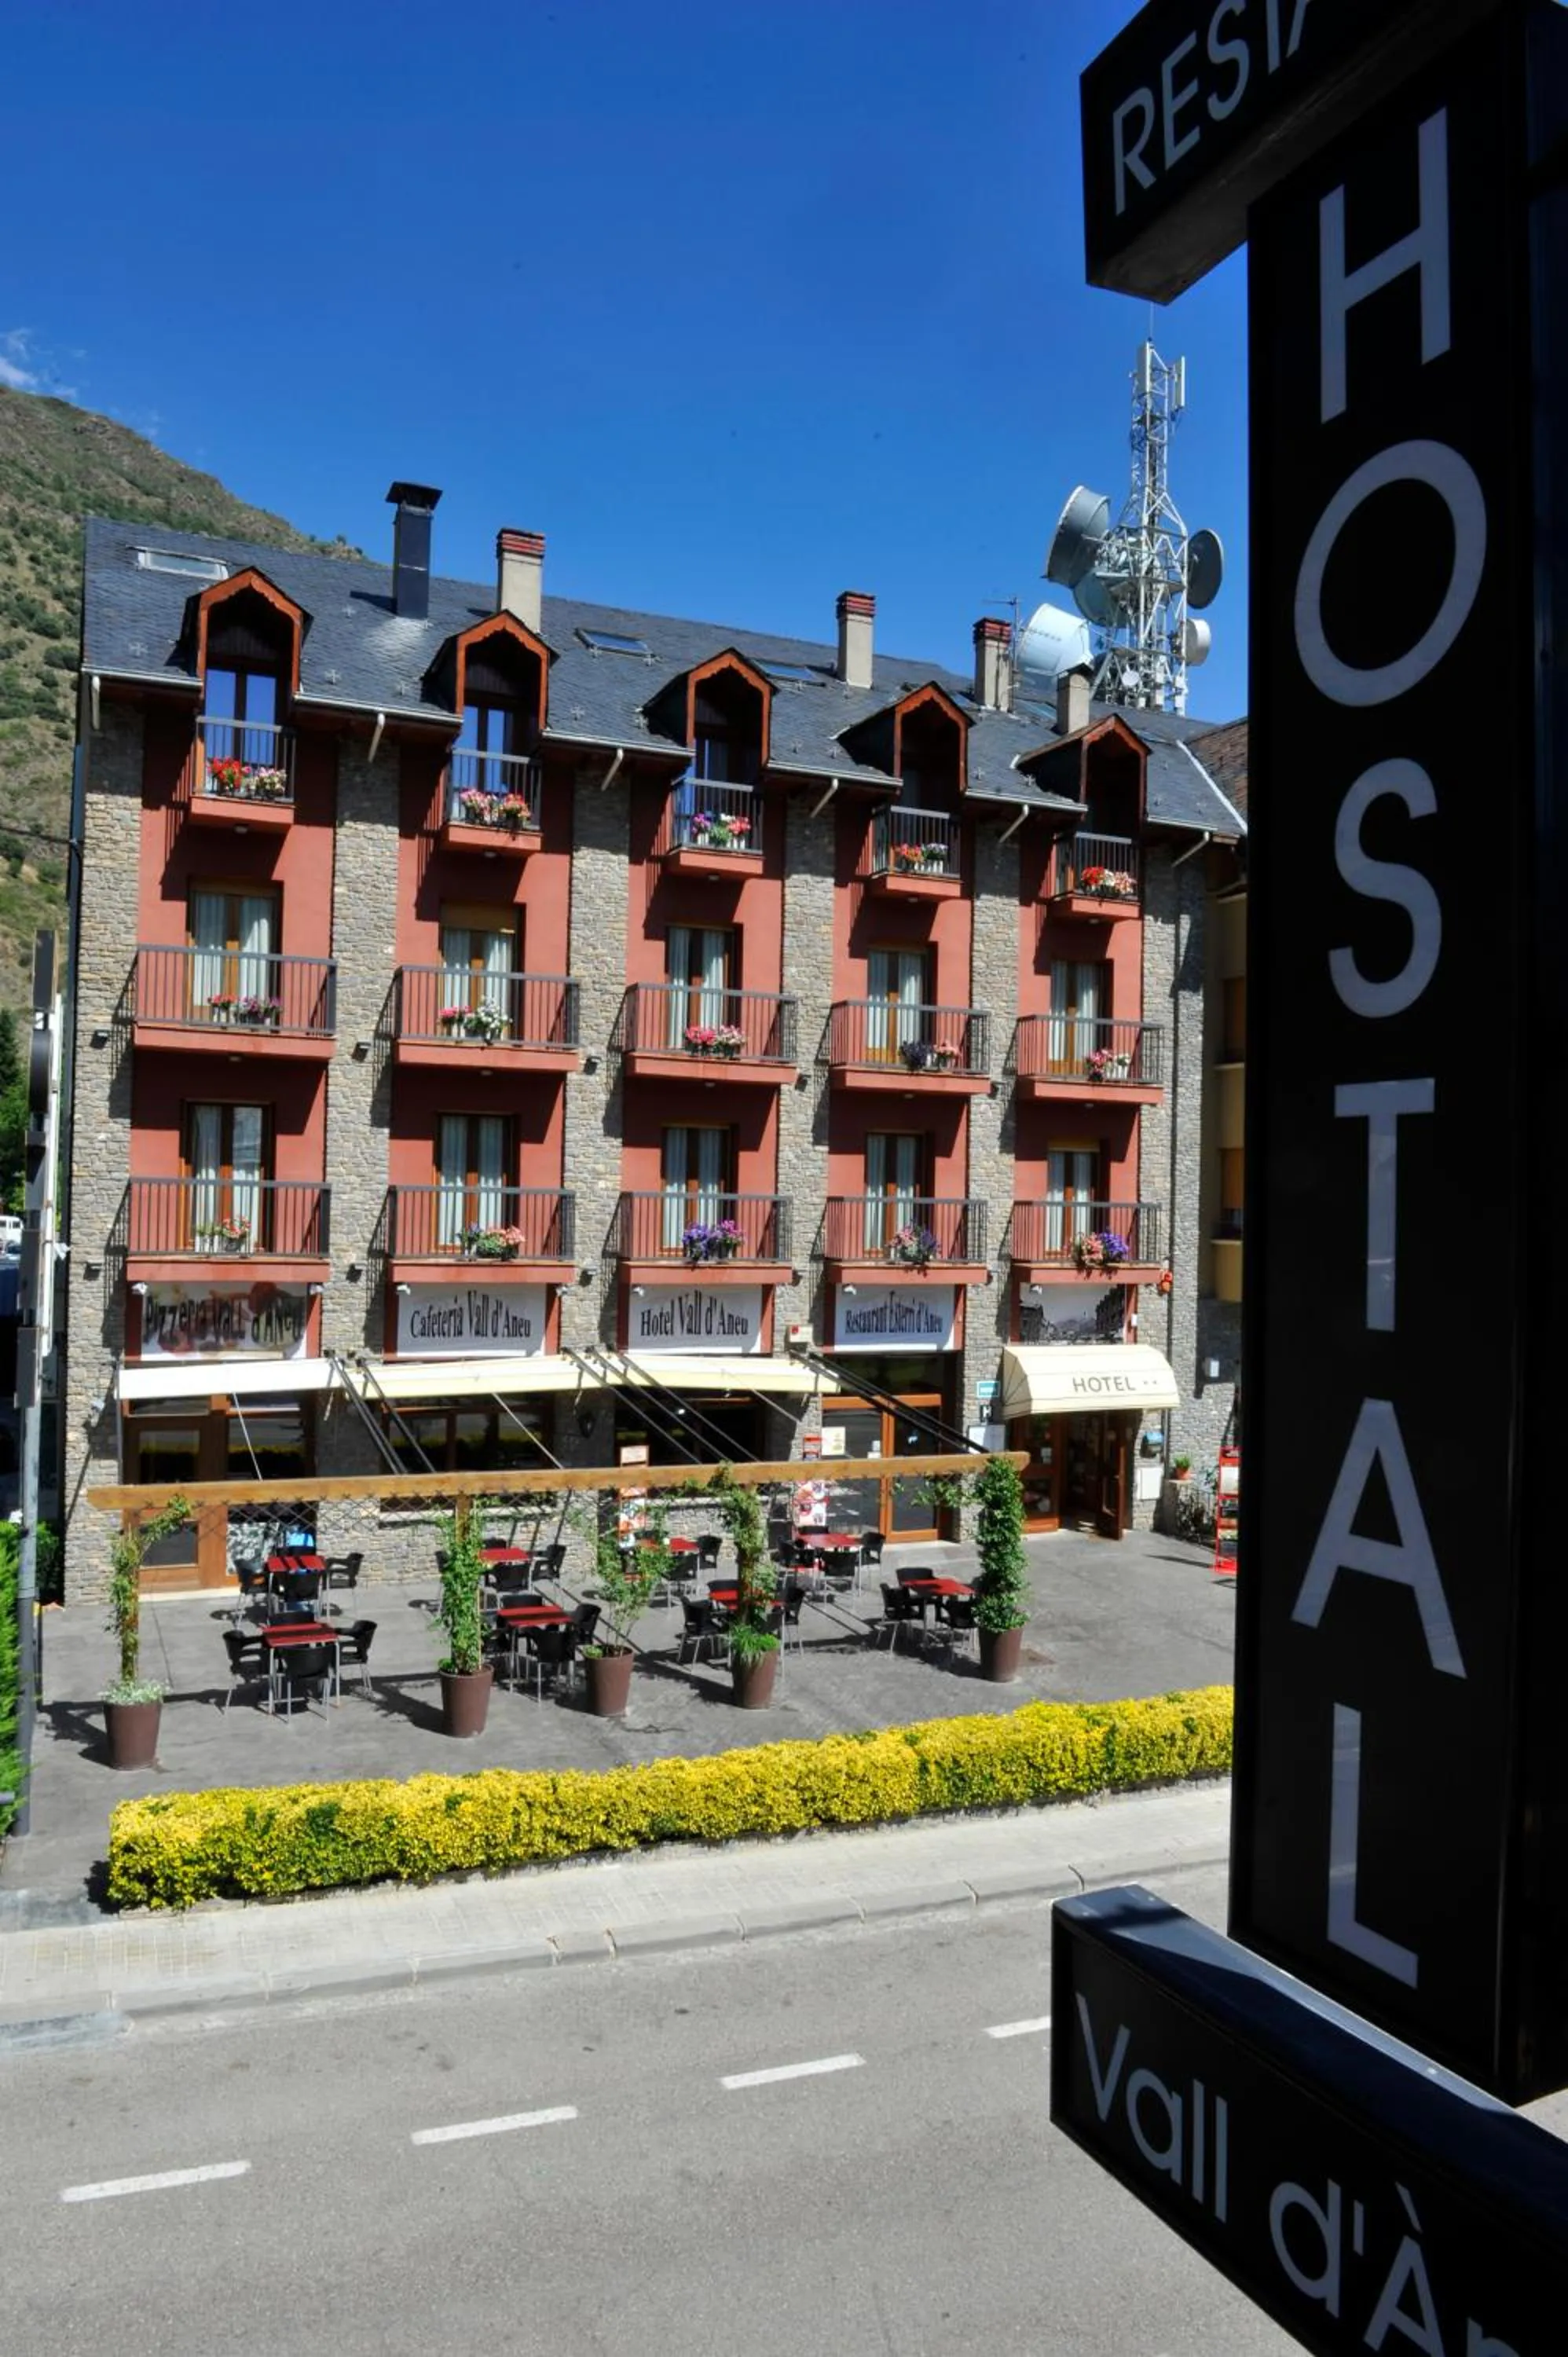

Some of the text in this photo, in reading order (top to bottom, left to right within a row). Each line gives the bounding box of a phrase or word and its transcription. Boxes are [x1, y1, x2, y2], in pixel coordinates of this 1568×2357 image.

[1293, 107, 1486, 1989] HOSTAL
[467, 1290, 489, 1337] Vall
[640, 1299, 675, 1336] Hotel
[678, 1289, 702, 1335] Vall
[1072, 1376, 1136, 1392] HOTEL
[1075, 1992, 1227, 2223] Vall
